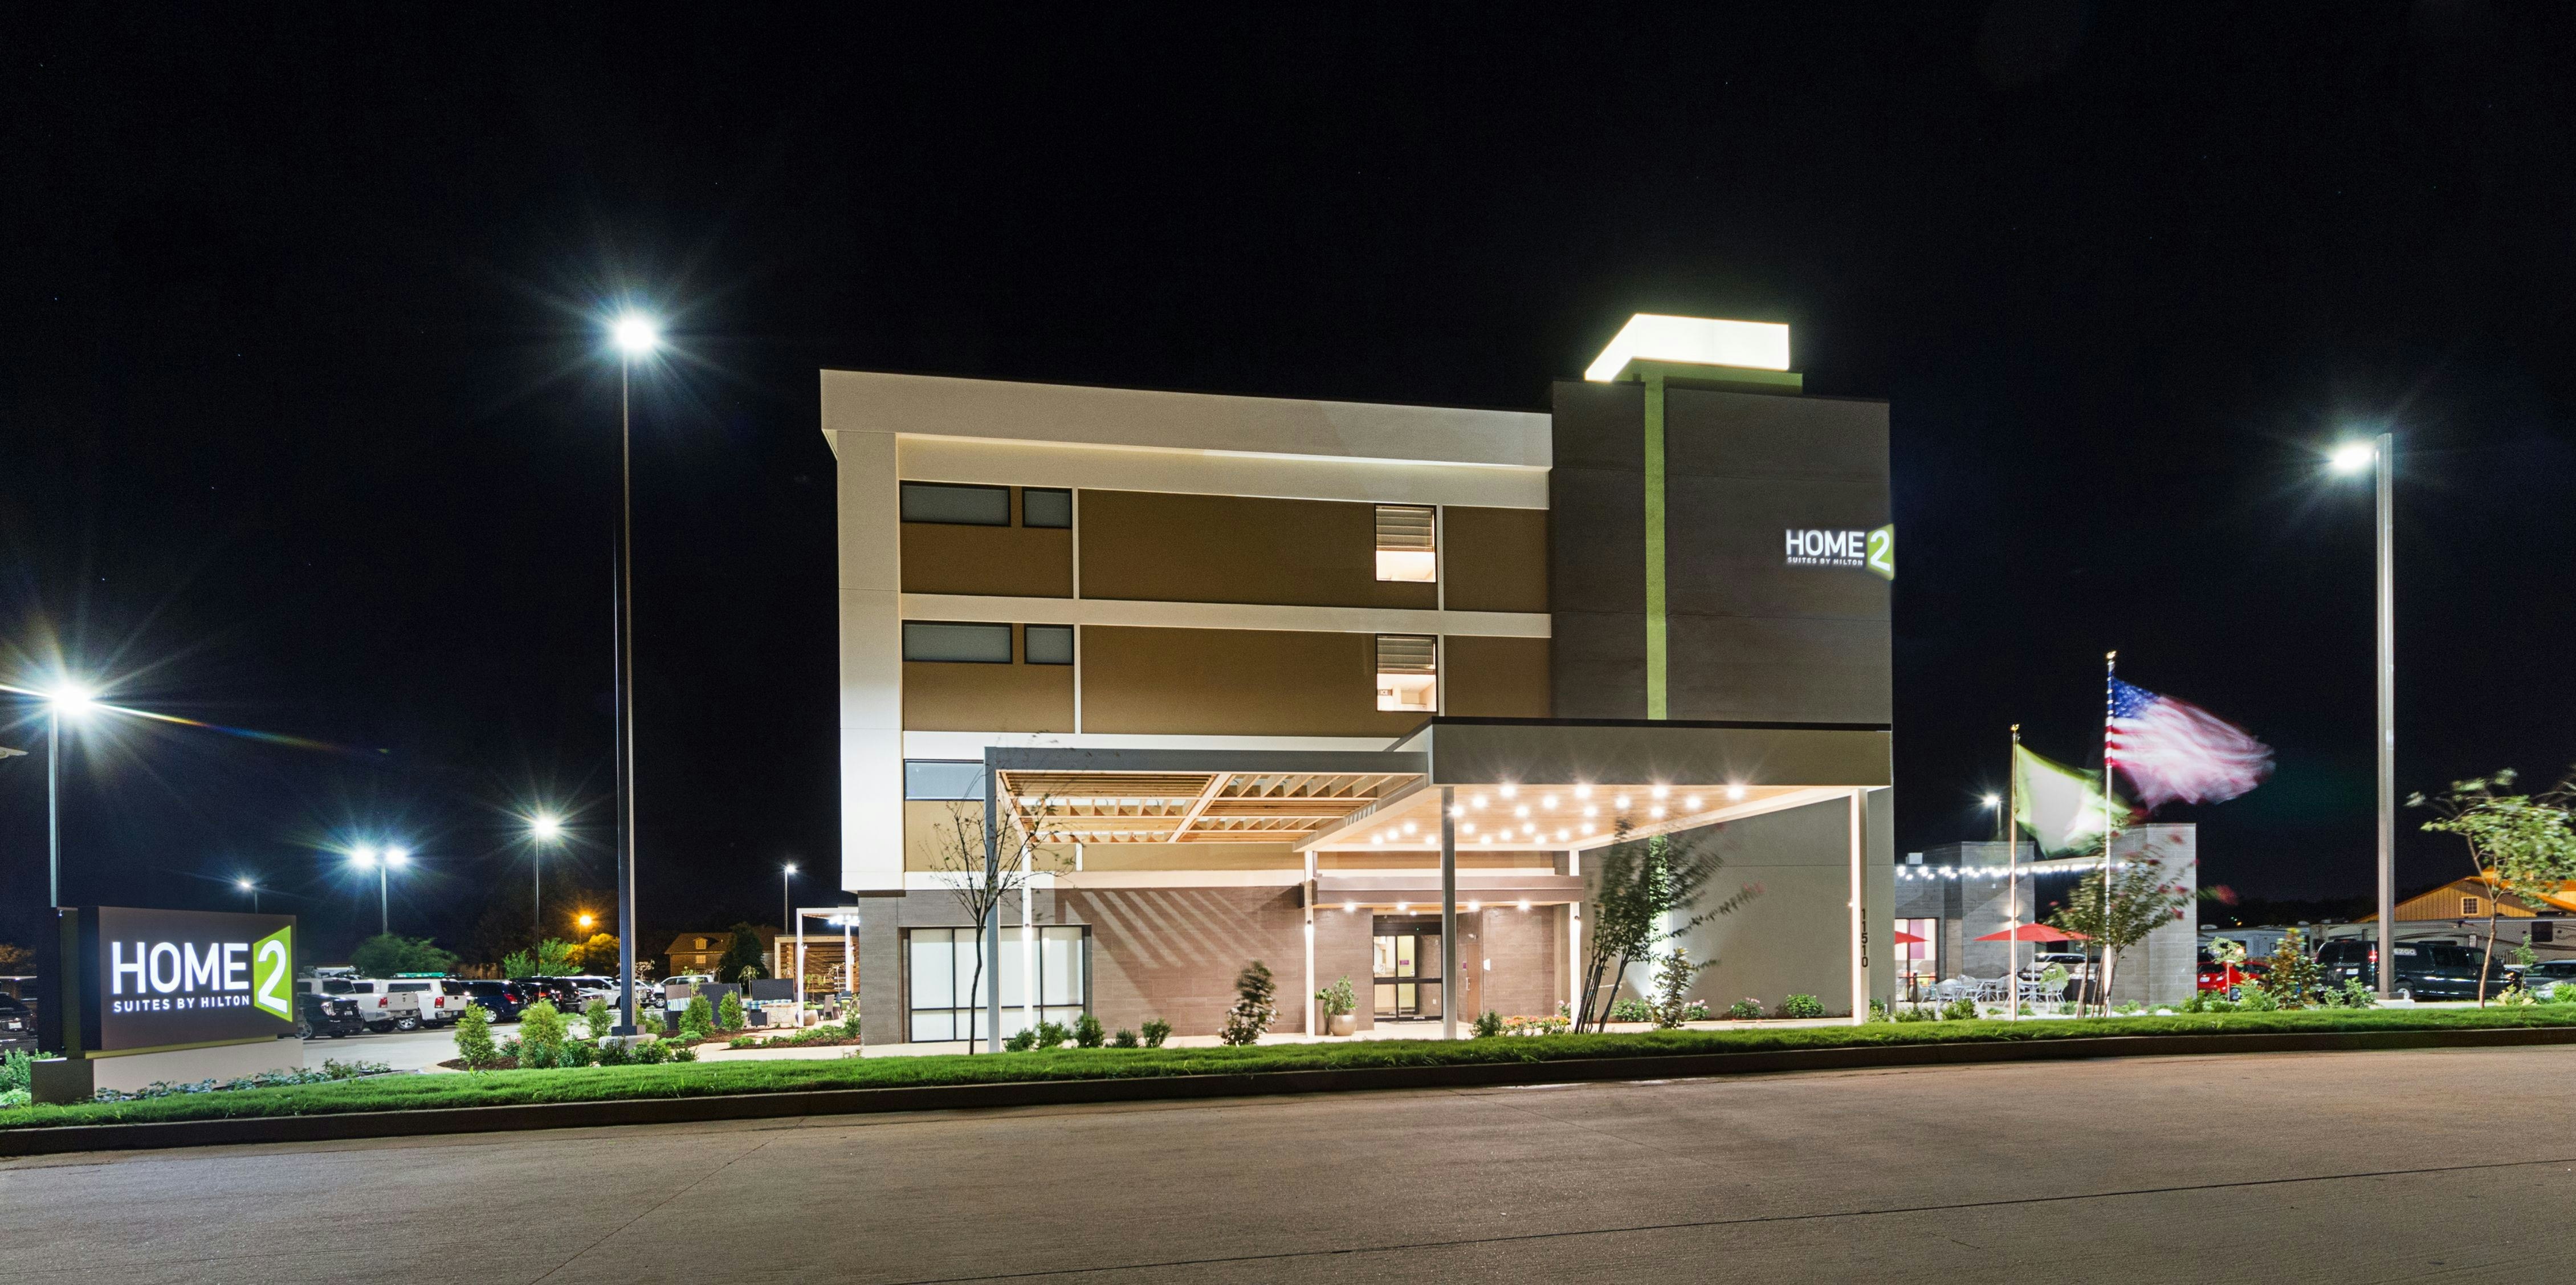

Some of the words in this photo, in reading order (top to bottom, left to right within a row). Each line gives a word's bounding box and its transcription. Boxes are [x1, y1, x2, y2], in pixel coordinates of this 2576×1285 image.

[113, 999, 170, 1012] SUITES
[177, 998, 195, 1009] BY
[201, 995, 250, 1008] HILTON
